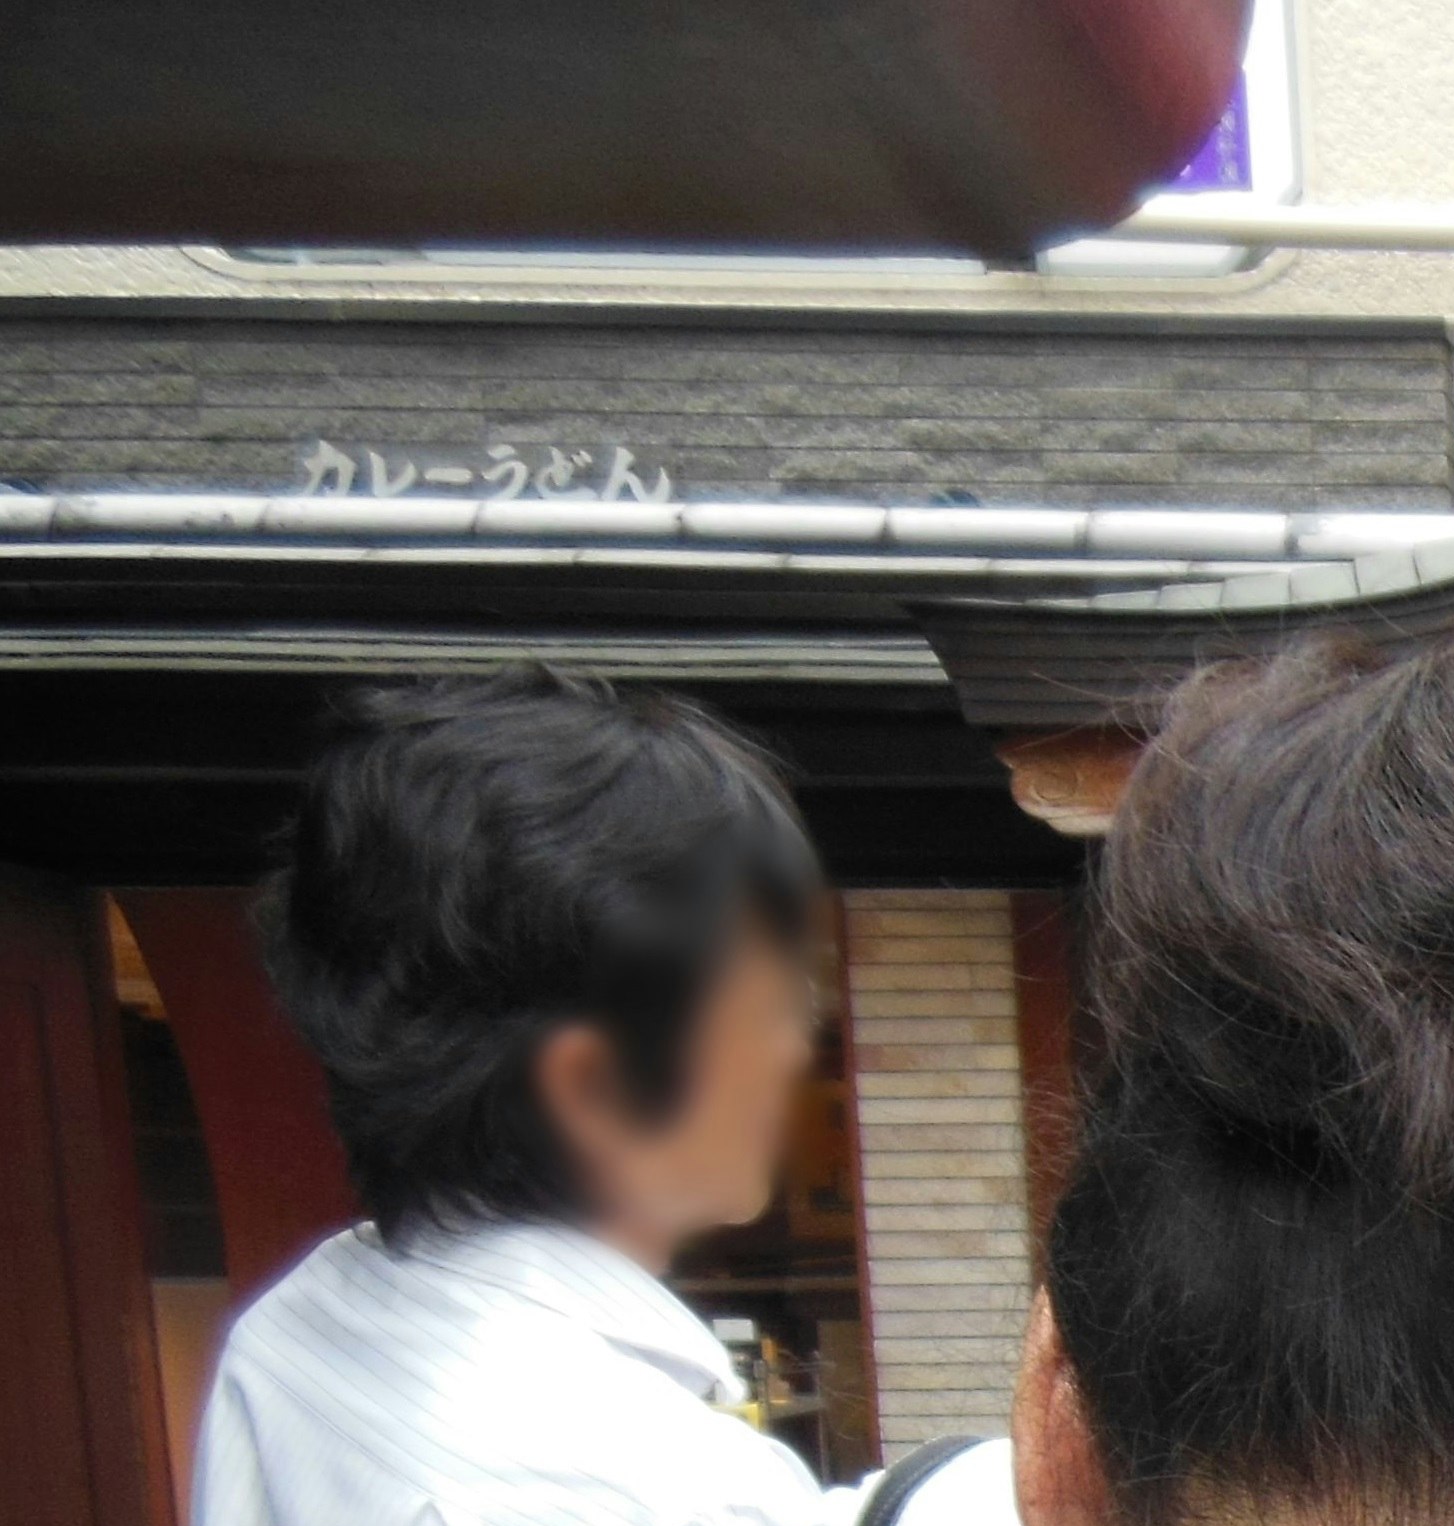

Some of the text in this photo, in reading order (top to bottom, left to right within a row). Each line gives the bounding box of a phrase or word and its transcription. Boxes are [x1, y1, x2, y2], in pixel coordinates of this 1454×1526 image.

[303, 439, 672, 502] カレーうどん
